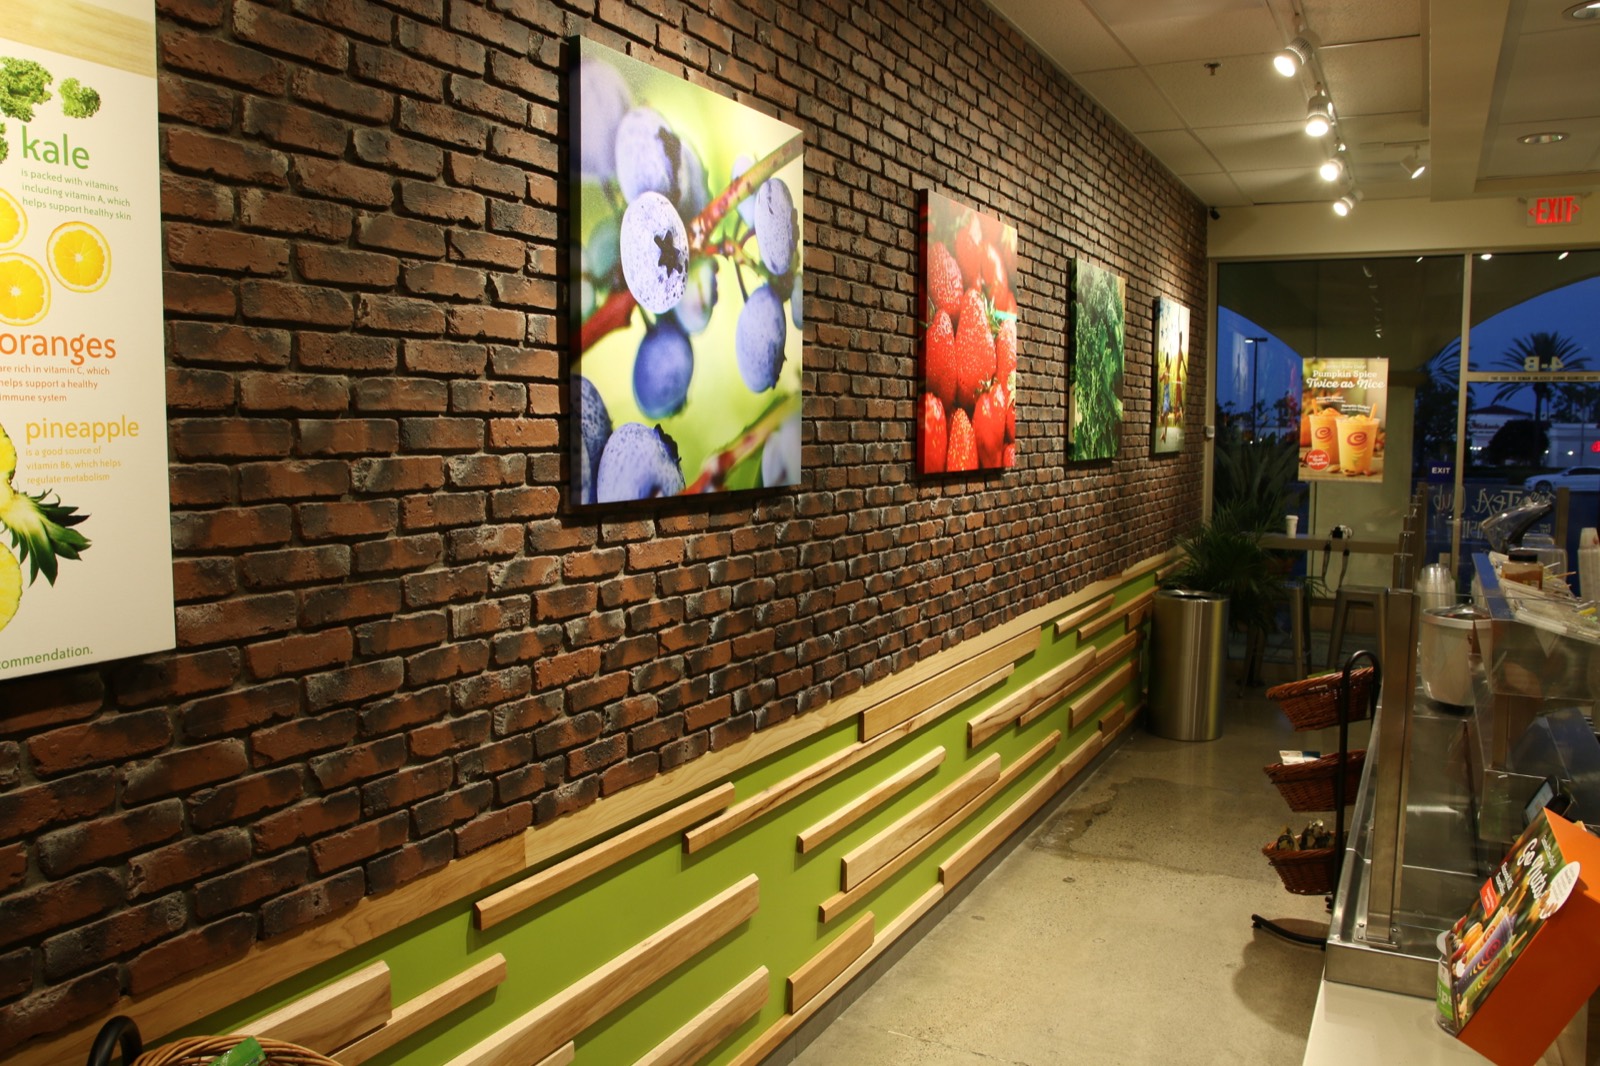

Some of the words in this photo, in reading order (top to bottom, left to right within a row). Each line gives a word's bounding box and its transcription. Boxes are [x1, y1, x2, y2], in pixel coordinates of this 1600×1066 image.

[21, 124, 90, 170] kale
[21, 169, 28, 177] is
[30, 169, 63, 183] packed
[64, 175, 83, 186] with
[84, 178, 119, 192] vitamins
[22, 183, 63, 199] including
[64, 189, 96, 202] vitamin
[97, 195, 106, 204] A,
[107, 197, 131, 207] which
[22, 197, 47, 209] helps
[48, 202, 82, 214] support
[83, 207, 114, 220] healthy
[115, 210, 132, 221] skin
[1536, 195, 1576, 225] EXIT
[0, 333, 117, 366] oranges
[14, 364, 31, 373] rich
[33, 365, 42, 374] in
[43, 365, 75, 374] vitamin
[76, 366, 85, 375] C,
[86, 366, 110, 376] which
[1312, 369, 1352, 379] Pumpkin
[1353, 370, 1378, 379] Spice
[25, 380, 59, 389] support
[67, 380, 98, 391] healthy
[1306, 377, 1340, 388] Twice
[1340, 380, 1355, 388] as
[1356, 378, 1385, 389] Nice
[37, 393, 67, 403] system
[25, 415, 139, 445] pineapple
[25, 447, 33, 457] is
[42, 447, 63, 457] good
[64, 447, 92, 455] source
[93, 446, 102, 454] of
[26, 462, 59, 471] vitamin
[74, 459, 98, 469] which
[99, 458, 122, 469] helps
[1431, 466, 1451, 475] EXIT
[27, 474, 61, 486] regulate
[63, 473, 110, 483] metabolism
[0, 646, 94, 670] ommendation.
